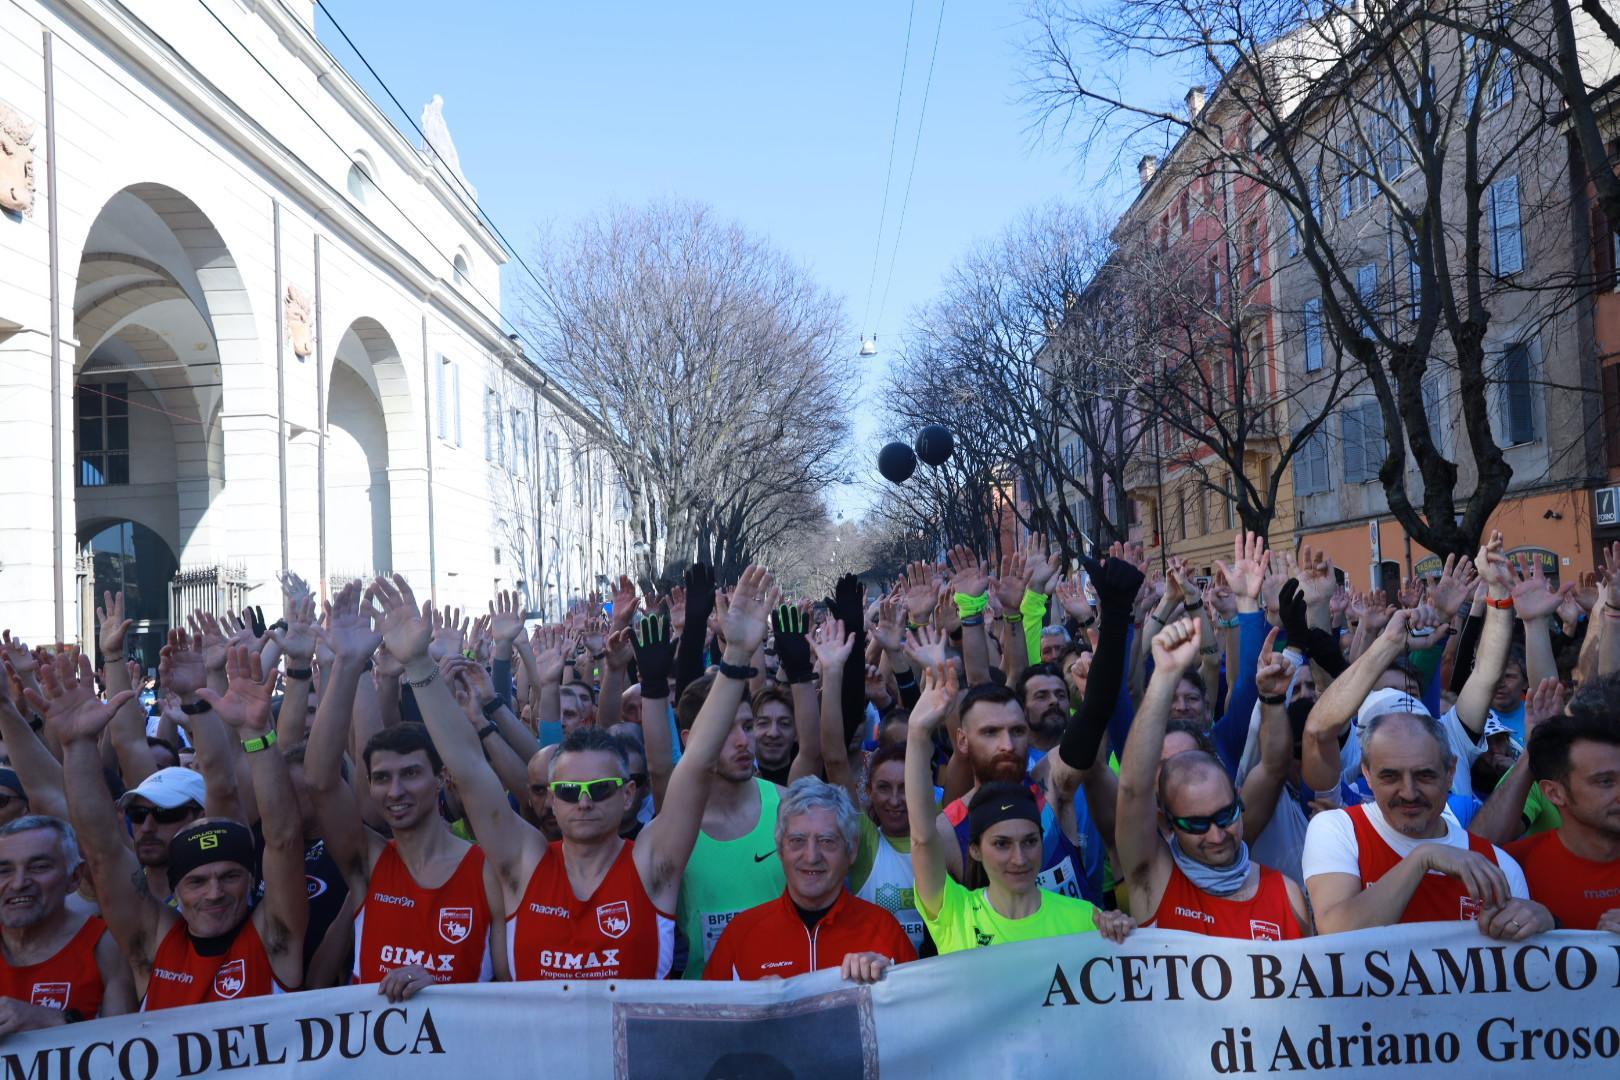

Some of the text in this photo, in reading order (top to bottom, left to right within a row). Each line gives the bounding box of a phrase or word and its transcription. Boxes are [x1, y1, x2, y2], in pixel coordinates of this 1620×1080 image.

[1597, 512, 1617, 521] FORNO
[374, 892, 415, 908] macron
[529, 903, 570, 919] macron
[380, 945, 455, 972] GIMAX
[540, 948, 620, 970] GIMAX
[155, 968, 194, 984] macron
[540, 967, 619, 979] Proposte Ceramiche
[1042, 954, 1233, 1006] ACETO
[1247, 945, 1598, 999] BALSAMICO
[0, 1008, 446, 1080] MICO DEL DUCA
[1210, 1016, 1620, 1074] di Adriano Groso
